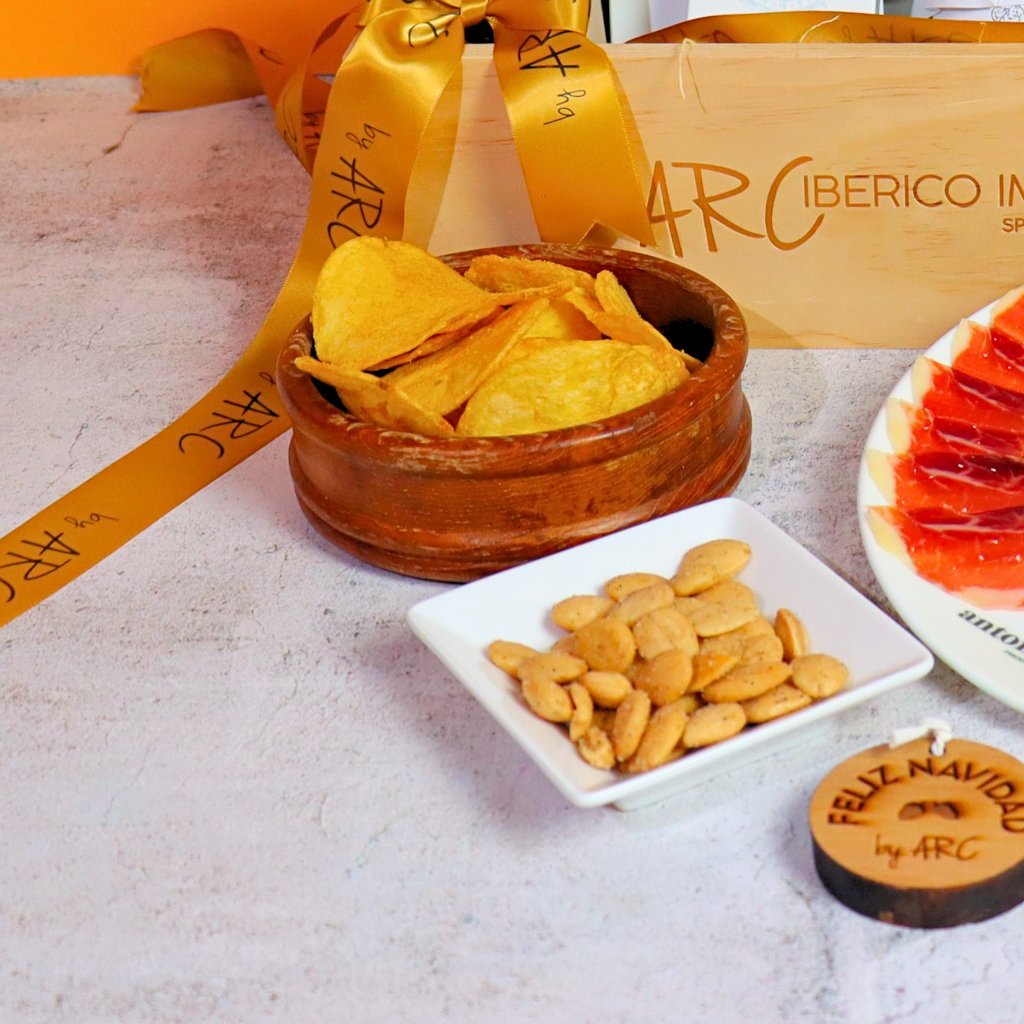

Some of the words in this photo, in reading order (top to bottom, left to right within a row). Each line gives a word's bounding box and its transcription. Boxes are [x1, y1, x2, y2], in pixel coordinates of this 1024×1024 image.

[543, 87, 586, 126] by
[346, 123, 392, 151] by
[641, 156, 826, 258] ARC
[803, 174, 981, 208] IBERICO
[179, 389, 280, 460] ARC
[828, 764, 902, 826] FELIZ
[874, 833, 902, 869] by
[912, 835, 984, 861] ARC
